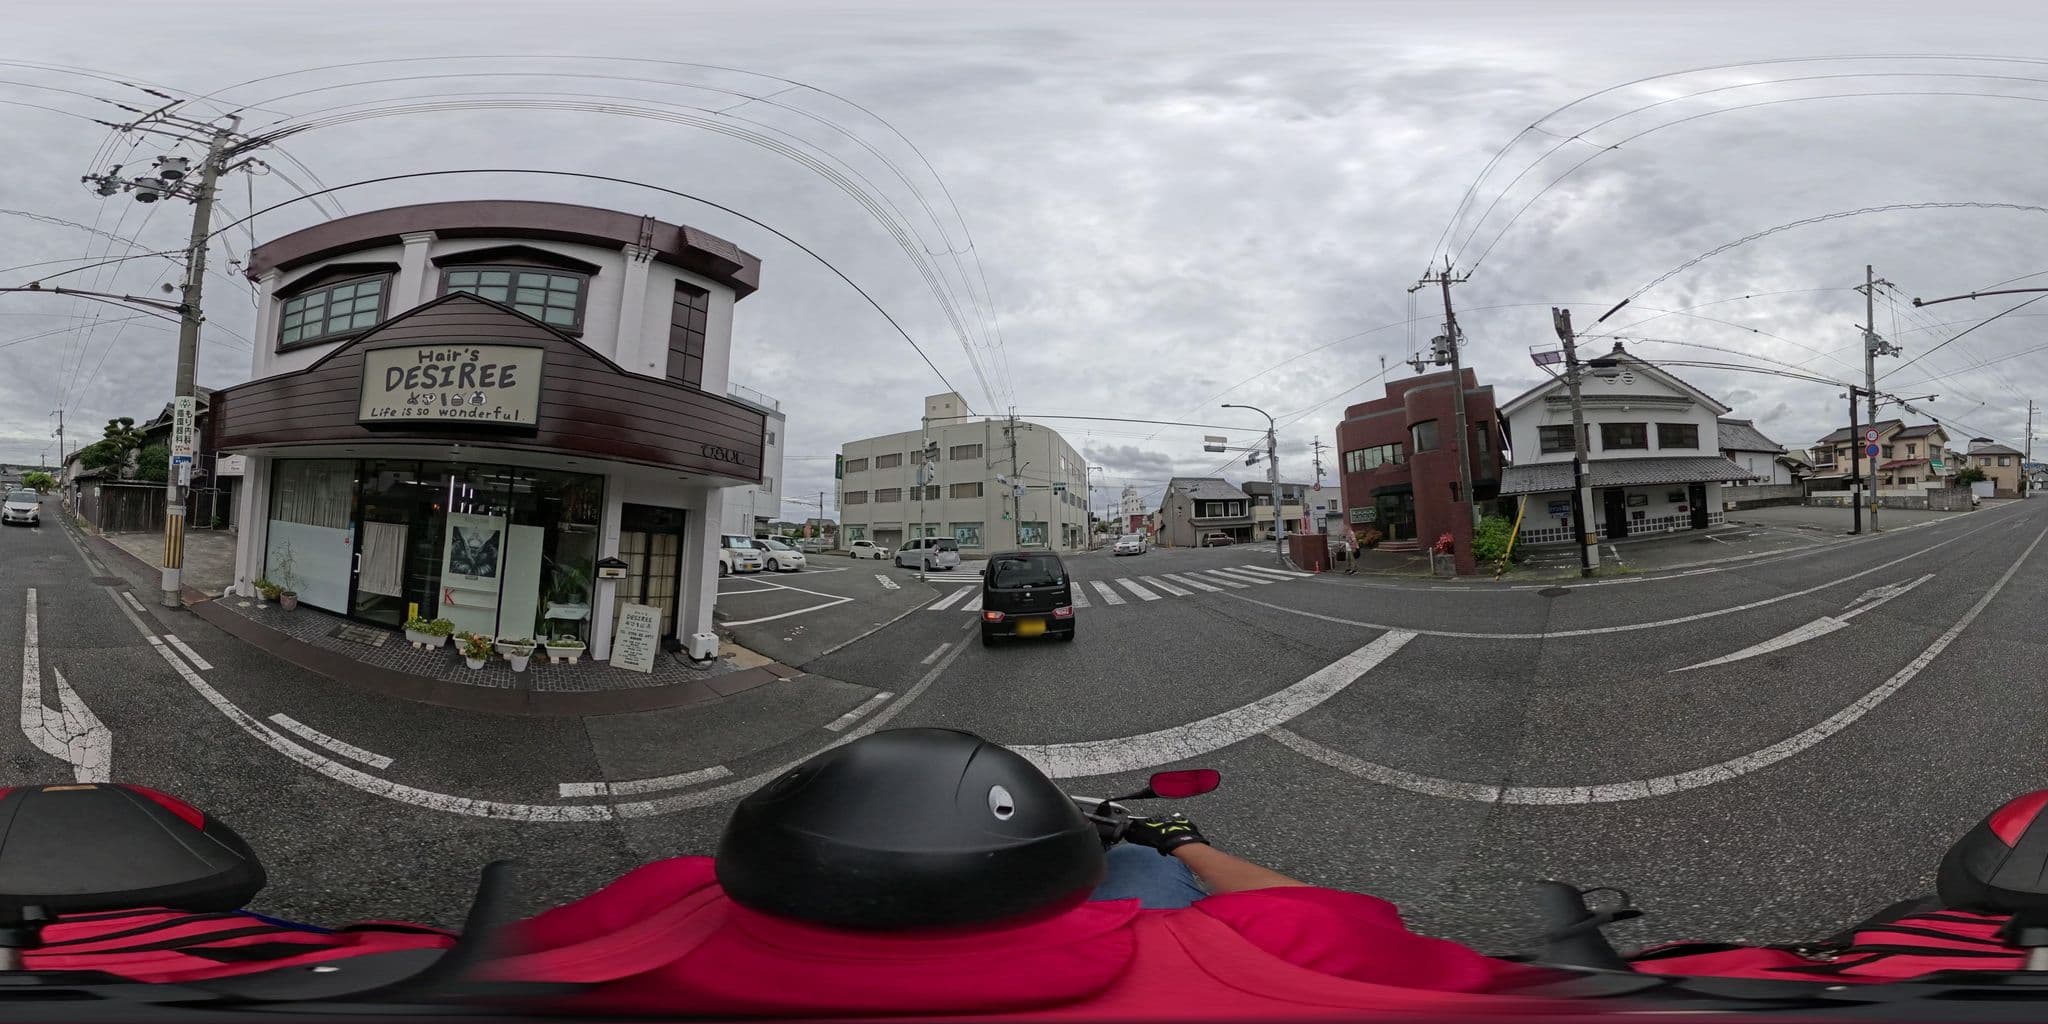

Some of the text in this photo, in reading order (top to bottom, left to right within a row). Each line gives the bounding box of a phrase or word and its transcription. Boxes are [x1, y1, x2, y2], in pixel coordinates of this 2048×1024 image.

[418, 349, 480, 363] Hair's
[385, 362, 517, 392] DESIREE
[370, 406, 397, 417] Life
[401, 407, 413, 417] is
[416, 407, 429, 416] so
